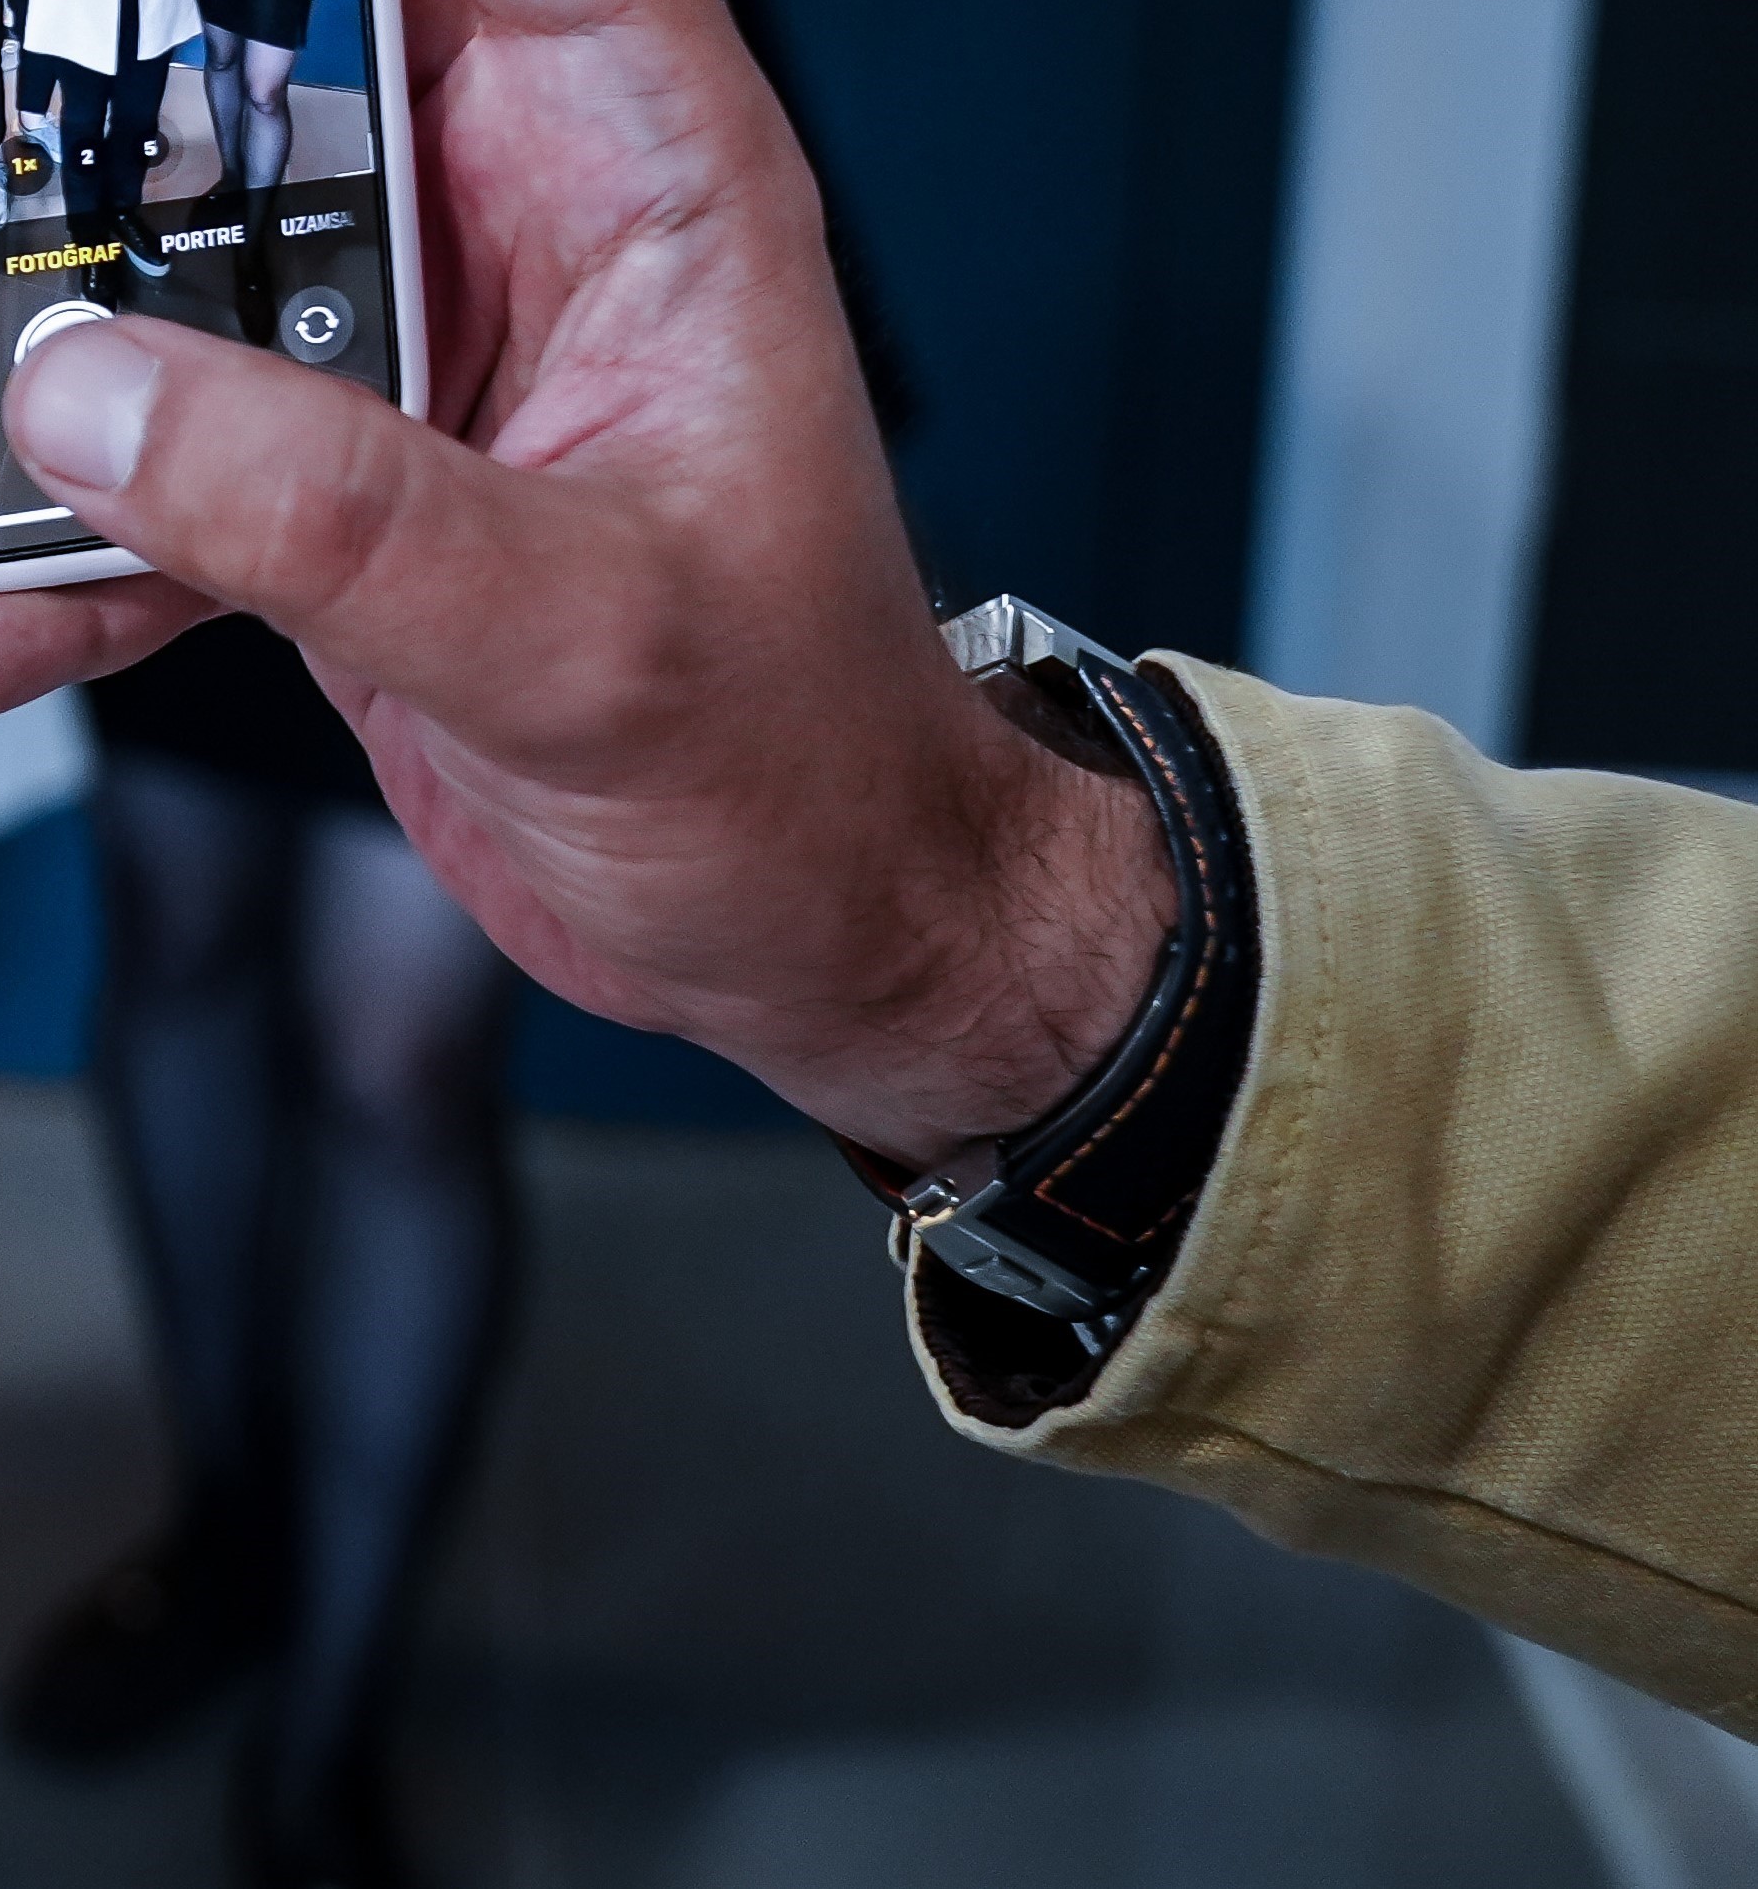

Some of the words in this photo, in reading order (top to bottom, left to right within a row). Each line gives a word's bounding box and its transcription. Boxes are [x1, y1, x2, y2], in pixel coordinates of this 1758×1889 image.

[81, 149, 94, 165] 2
[143, 140, 157, 157] 5
[5, 242, 122, 277] FOTOĞRAF
[160, 224, 246, 254] PORTRE
